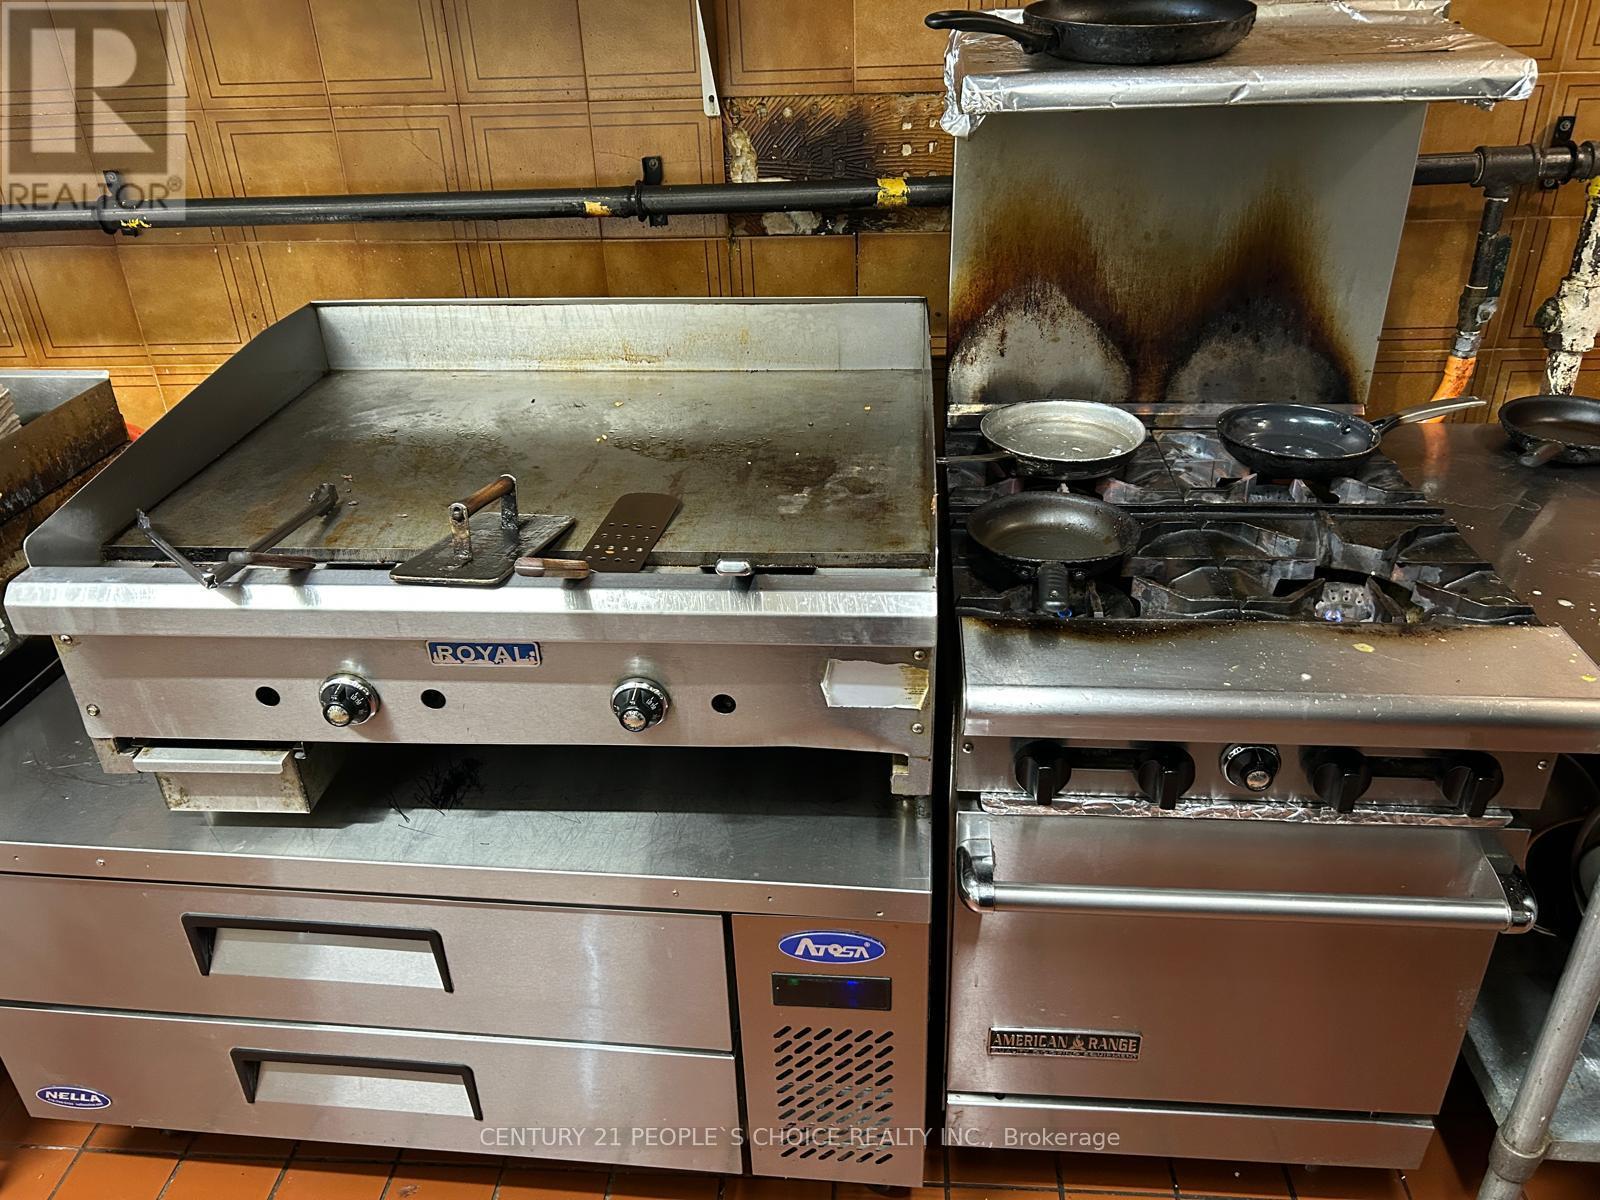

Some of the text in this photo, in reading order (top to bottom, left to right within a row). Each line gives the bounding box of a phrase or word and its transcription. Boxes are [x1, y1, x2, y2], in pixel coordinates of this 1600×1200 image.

[993, 1033, 1137, 1052] AMERICAN RANGE
[45, 1091, 102, 1103] NELLA
